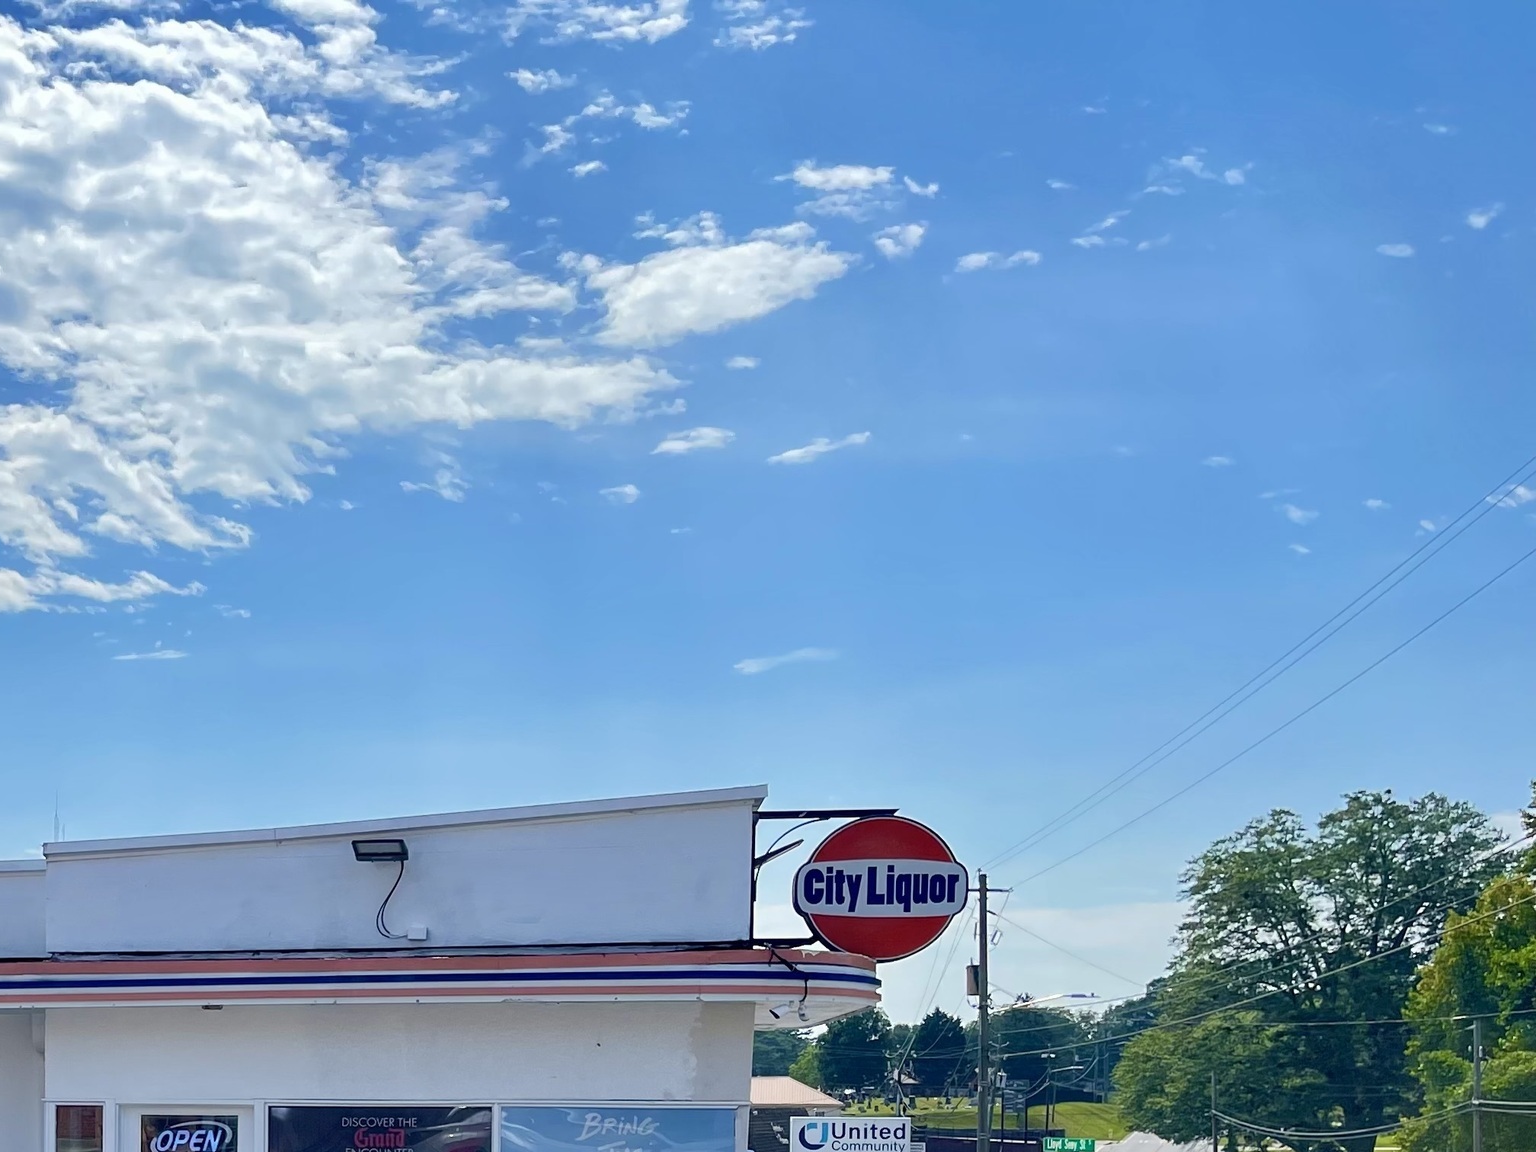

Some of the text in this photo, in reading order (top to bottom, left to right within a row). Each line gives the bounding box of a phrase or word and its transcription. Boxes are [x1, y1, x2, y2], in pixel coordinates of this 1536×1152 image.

[803, 864, 960, 913] City Liquor
[341, 1116, 418, 1128] DISCOVER THE
[831, 1122, 907, 1140] United
[156, 1129, 222, 1152] OPEN
[354, 1127, 406, 1149] Grand
